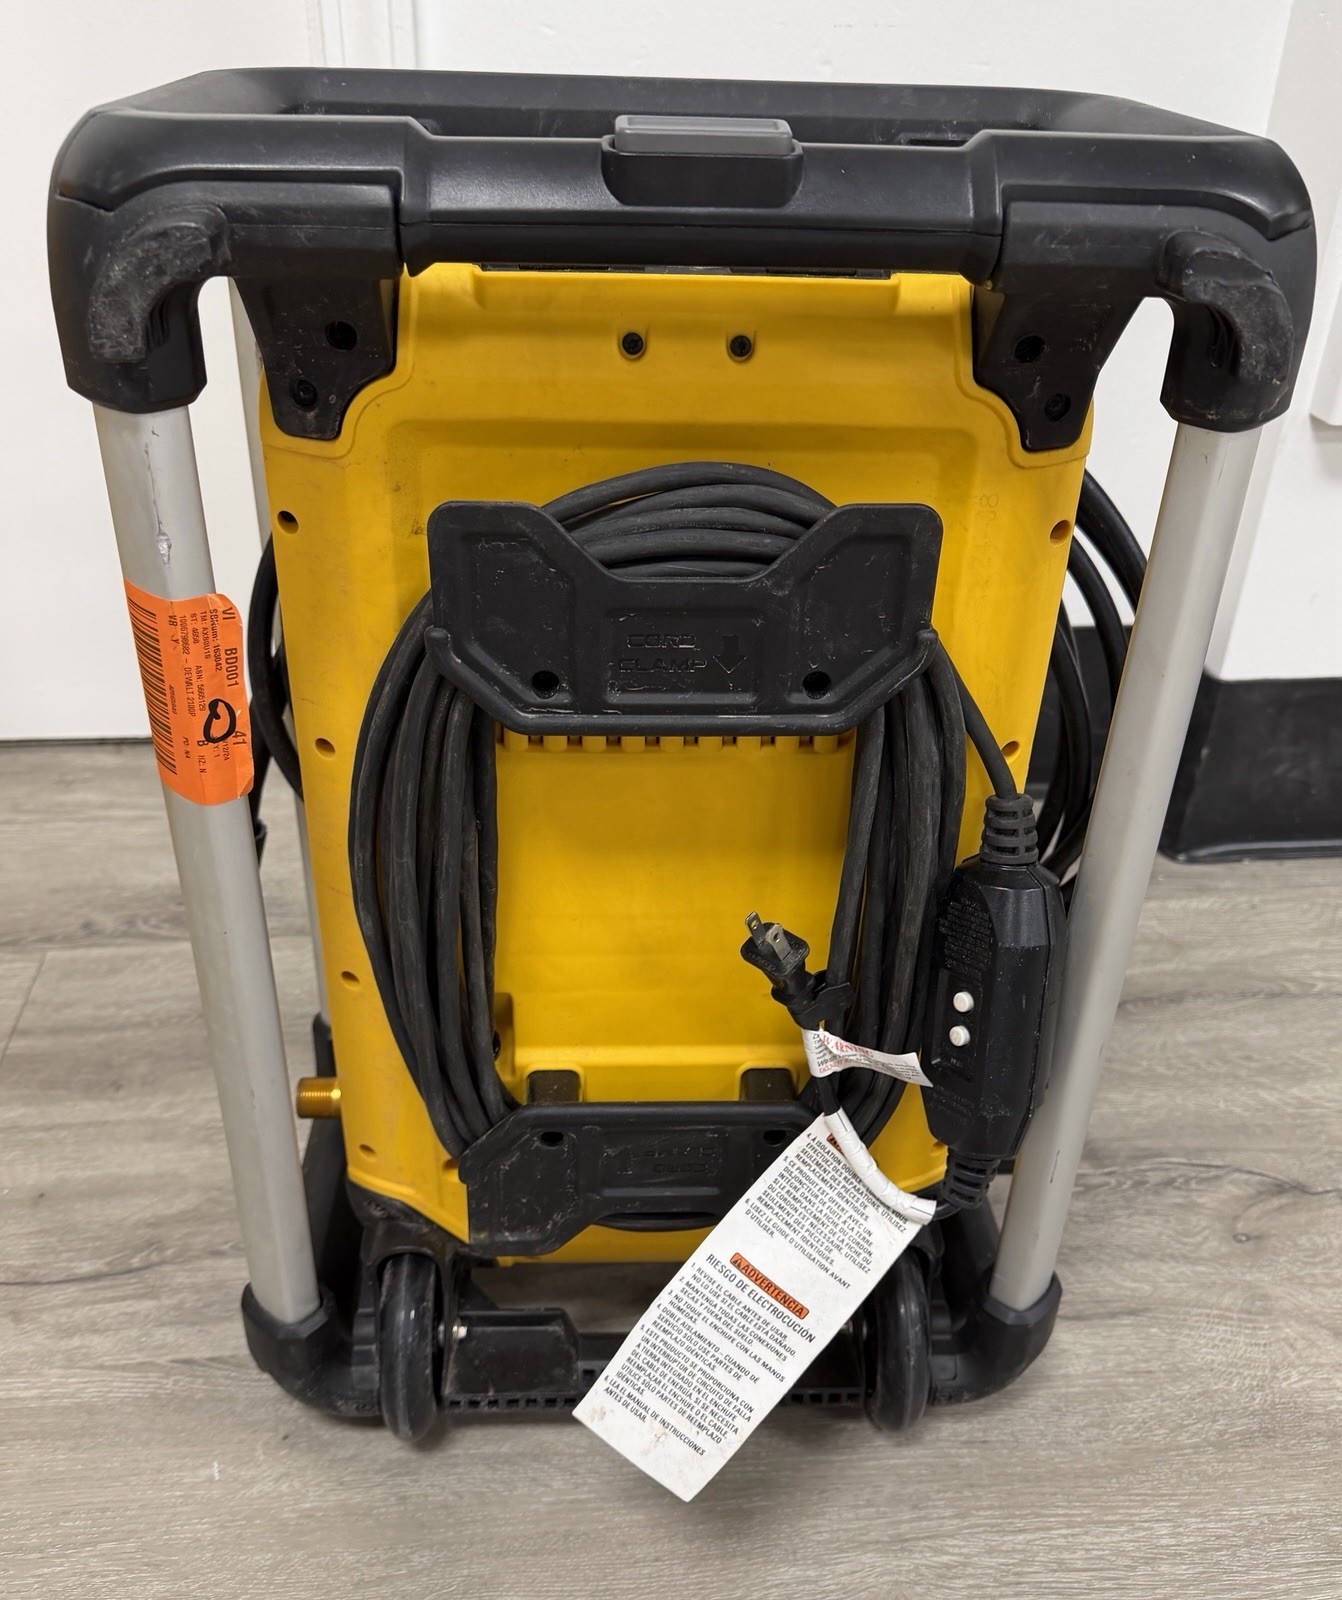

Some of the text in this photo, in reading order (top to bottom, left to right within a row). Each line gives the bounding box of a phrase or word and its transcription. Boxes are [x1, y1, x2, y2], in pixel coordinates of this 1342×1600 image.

[221, 606, 247, 745] VI BD001 41
[704, 1254, 816, 1344] RIESGO DE ELECTROCUCIÓN
[740, 1263, 805, 1317] ADVERTENCIA
